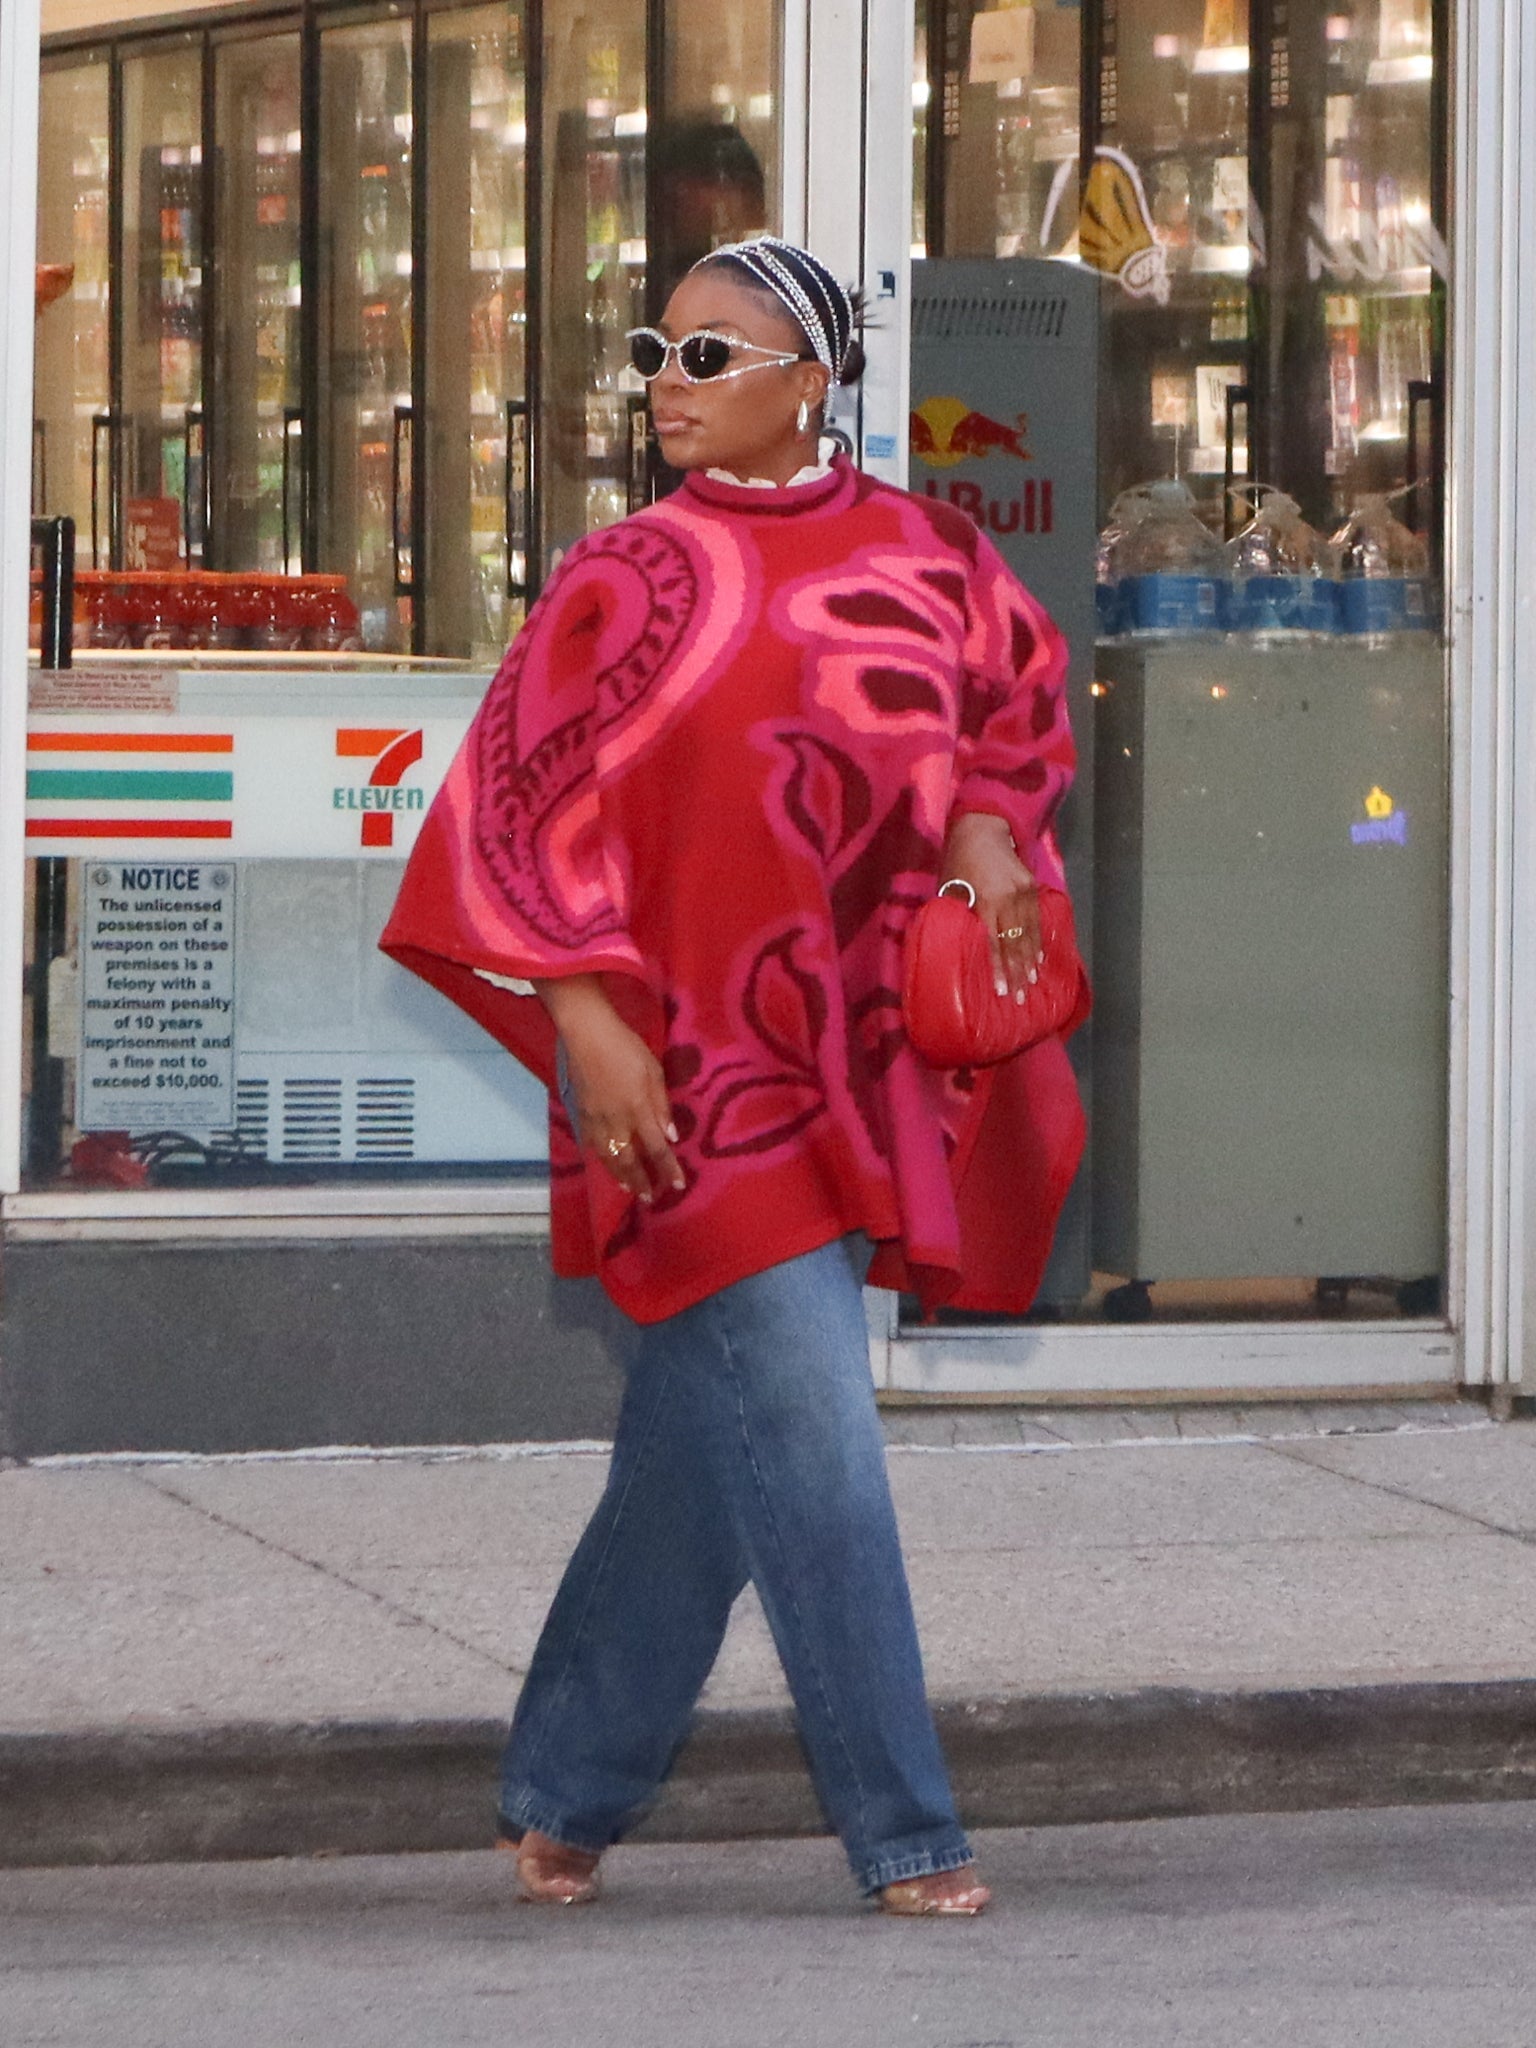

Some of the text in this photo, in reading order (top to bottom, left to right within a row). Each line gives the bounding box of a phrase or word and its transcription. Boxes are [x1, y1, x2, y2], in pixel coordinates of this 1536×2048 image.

[336, 729, 423, 847] 7
[333, 788, 424, 810] ELEVEN
[121, 868, 200, 890] NOTICE
[100, 898, 222, 912] The unlicensed
[97, 918, 223, 934] possession of a
[91, 938, 229, 954] weapon on these
[105, 958, 213, 974] premises is a
[107, 977, 211, 993] felony with a
[86, 997, 231, 1013] maximum penalty
[113, 1015, 203, 1033] of 10 years
[85, 1035, 231, 1051] imprisonment and
[109, 1055, 207, 1068] a fine not to
[92, 1074, 223, 1090] exceed $10,000.
